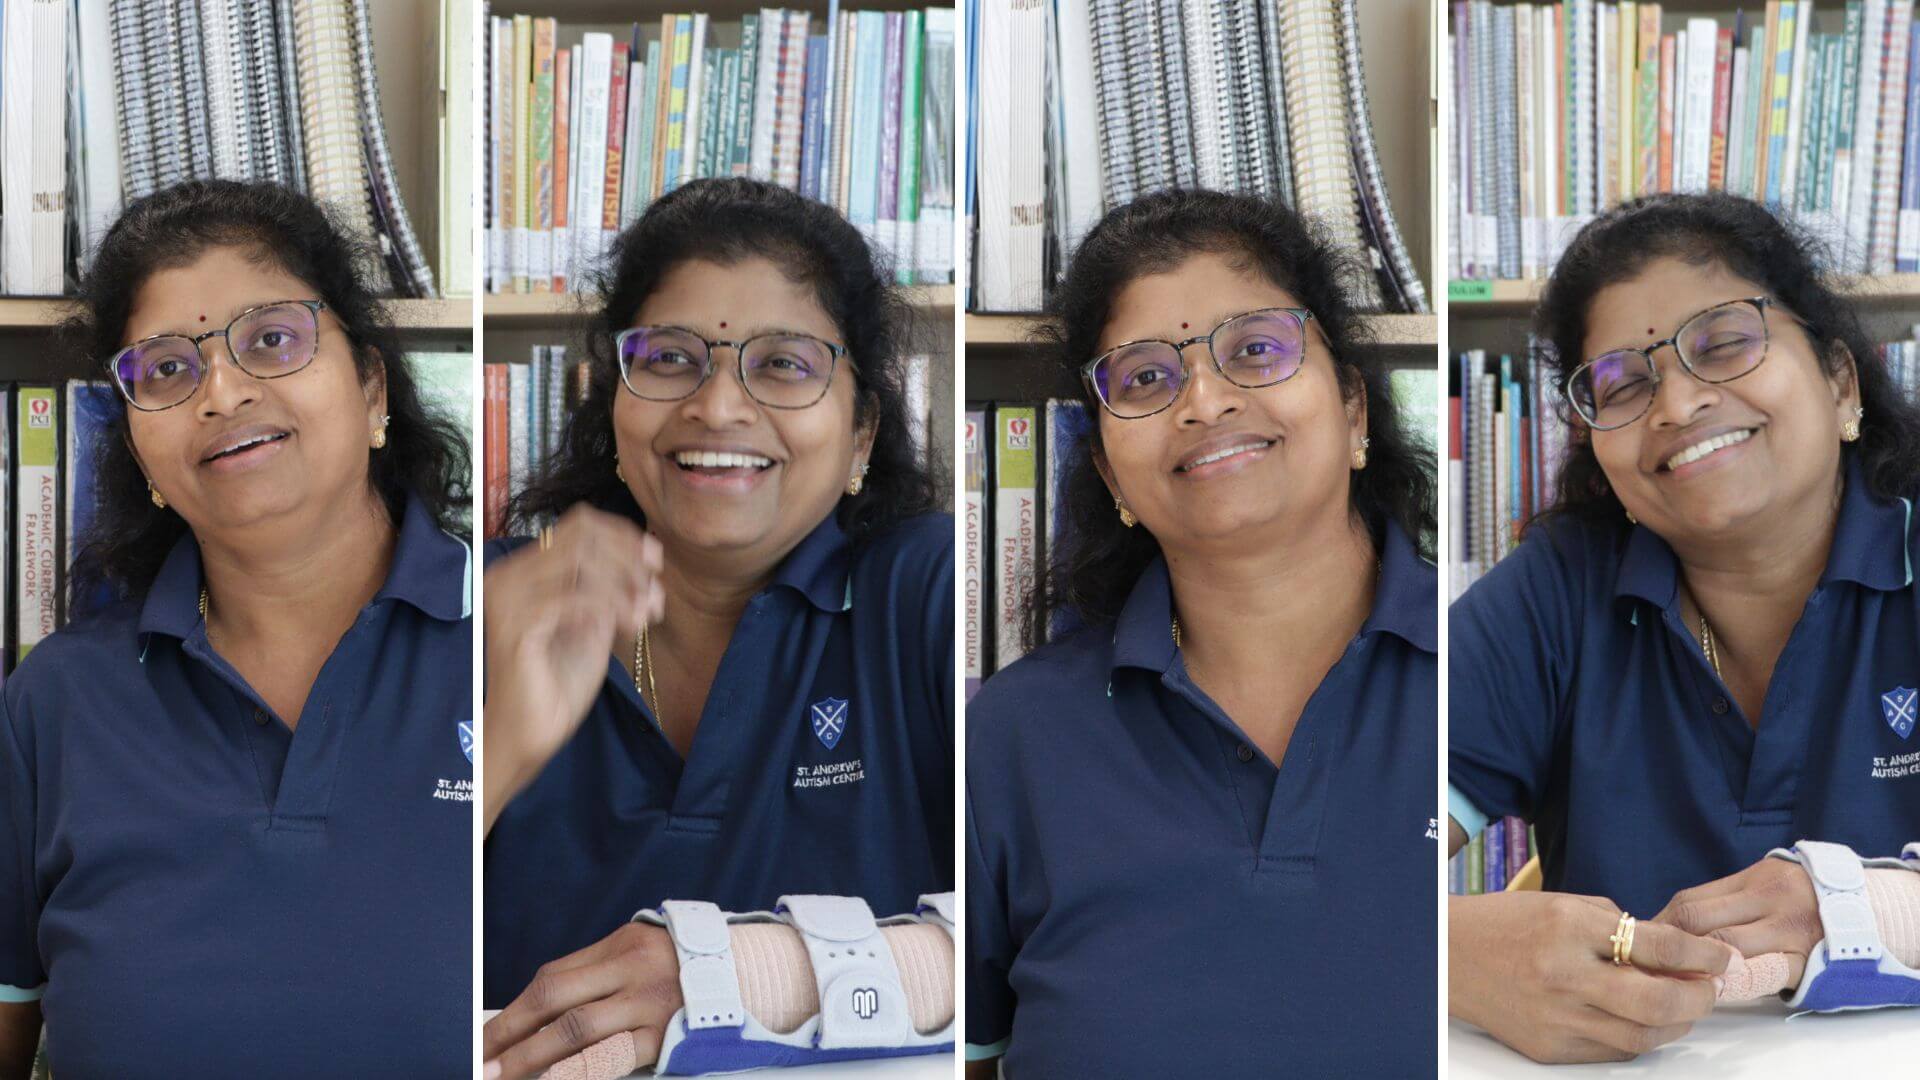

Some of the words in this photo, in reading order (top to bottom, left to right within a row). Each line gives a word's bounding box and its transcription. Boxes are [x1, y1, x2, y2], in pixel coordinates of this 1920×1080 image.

[603, 149, 619, 227] AUTISM
[1009, 436, 1028, 445] PCI
[41, 475, 52, 545] ACADEMIC
[966, 502, 978, 573] ACADEMIC
[1020, 498, 1032, 568] ACADEMIC
[25, 513, 37, 598] FRAMEWORK
[1004, 537, 1016, 625] FRAMEWORK
[40, 549, 53, 635] CURRICULUM
[966, 579, 979, 668] CURRICULUM
[437, 778, 452, 789] ST.
[454, 779, 473, 791] AN
[793, 776, 831, 788] AUTISM
[797, 767, 811, 776] ST.
[812, 759, 861, 776] ANDREW'S
[1871, 765, 1908, 778] AUTISM
[1873, 757, 1887, 767] ST.
[1889, 751, 1920, 766] ANDRE
[1428, 818, 1438, 828] S
